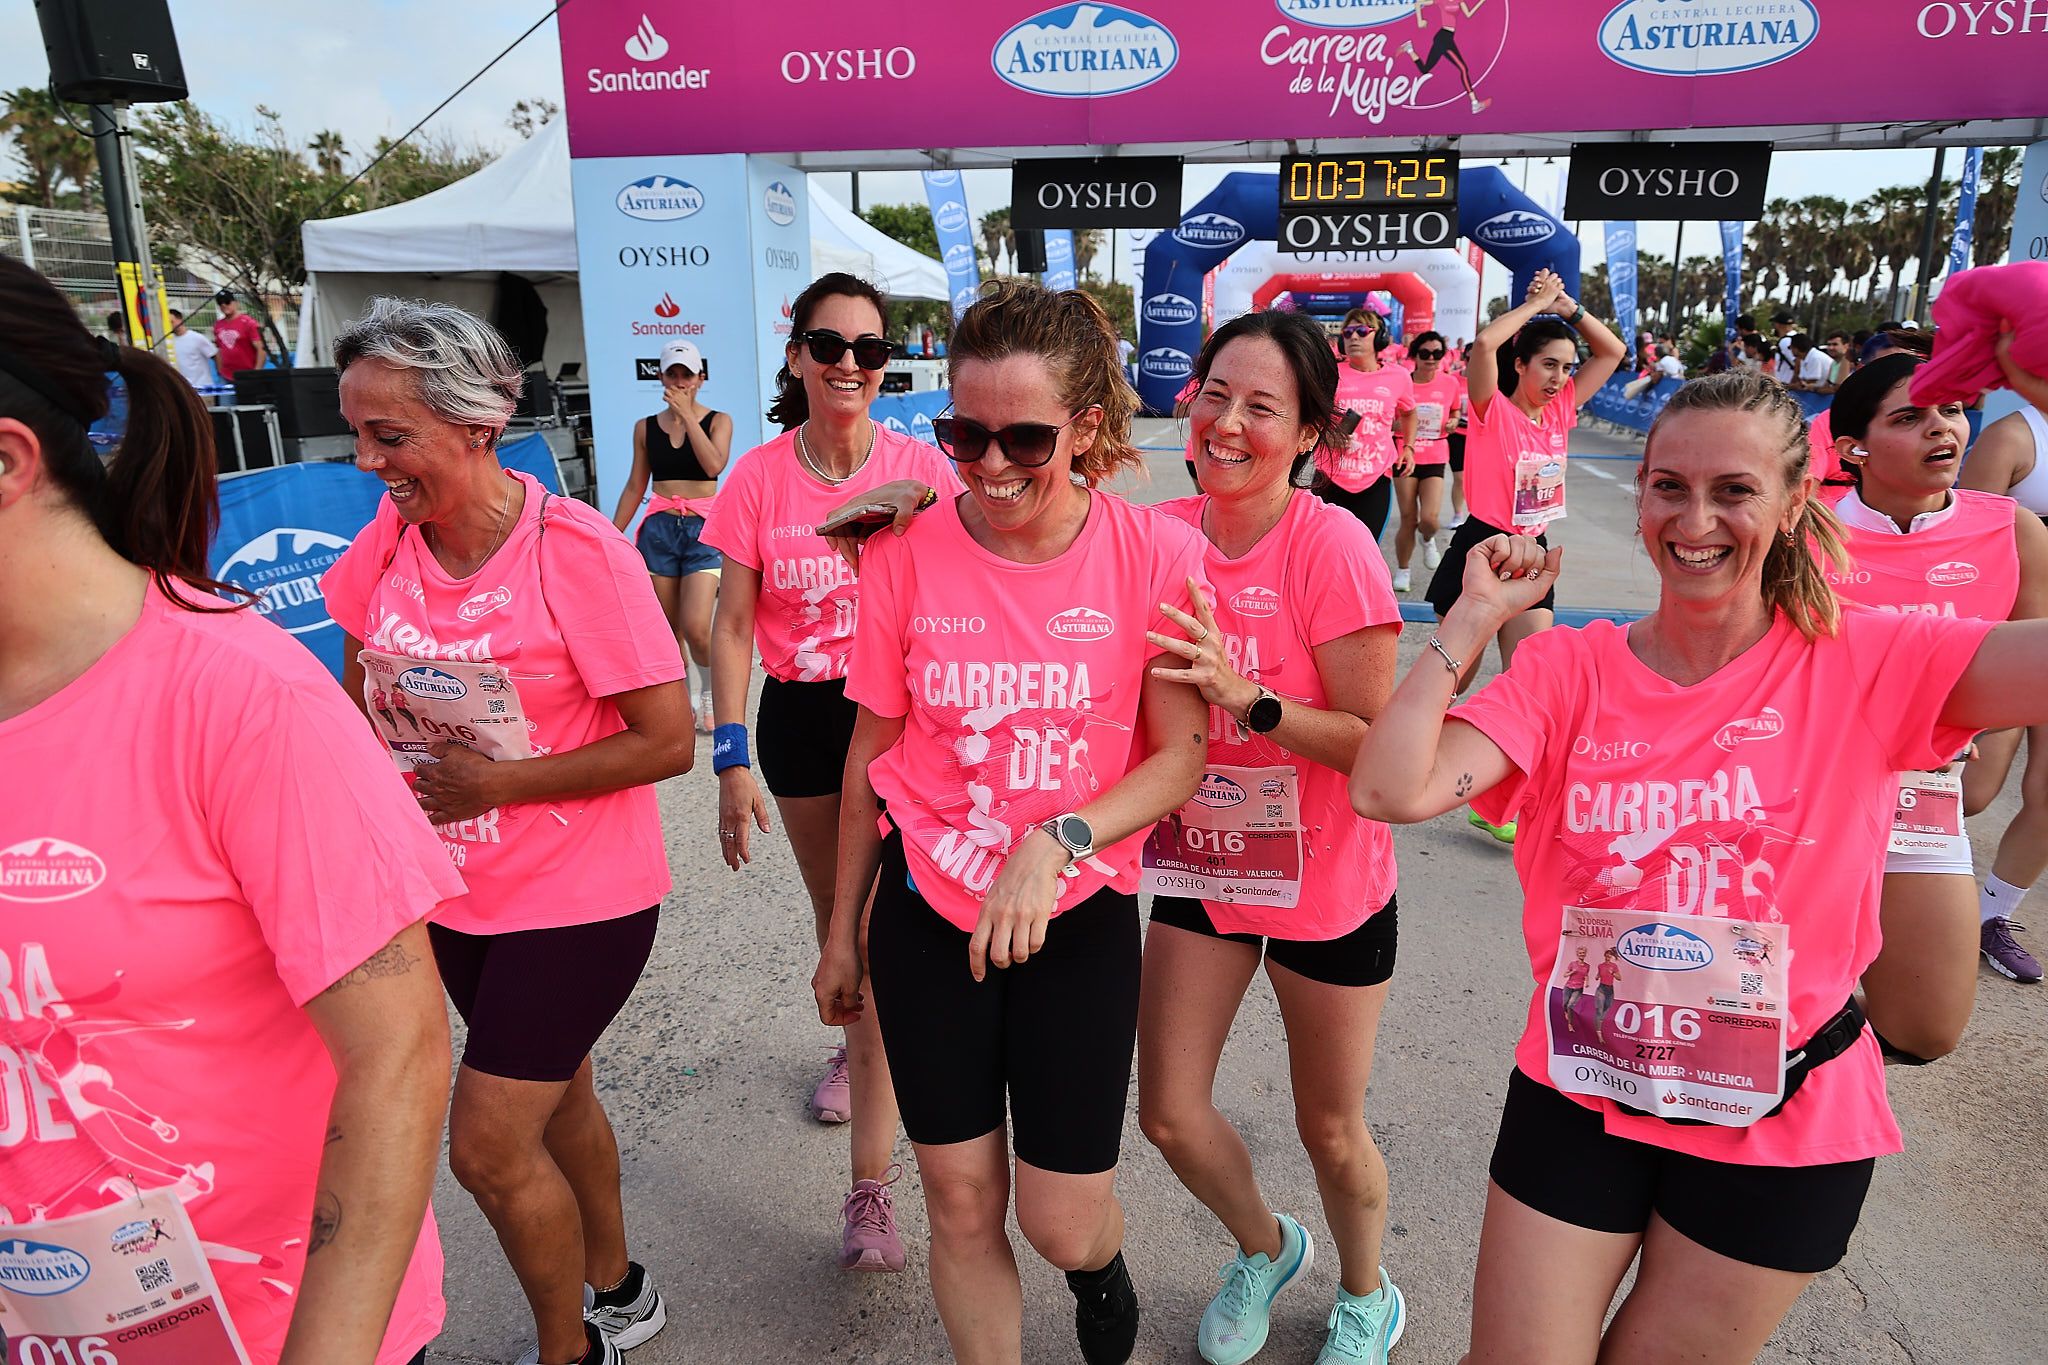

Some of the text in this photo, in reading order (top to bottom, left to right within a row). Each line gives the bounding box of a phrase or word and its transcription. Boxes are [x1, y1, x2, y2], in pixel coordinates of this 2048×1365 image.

[1649, 4, 1797, 20] CENTRAL LECHERA
[1033, 32, 1159, 46] CENTRAL LECHERA
[1613, 14, 1800, 52] ASTURIANA
[1006, 40, 1164, 74] ASTURIANA
[1260, 25, 1388, 66] Carrera
[780, 46, 917, 84] OYSHO
[587, 64, 711, 93] Santander
[1289, 57, 1433, 124] de la Mujer
[1289, 157, 1447, 201] 00:37:25
[1598, 167, 1740, 198] OYSHO
[623, 194, 698, 211] ASTURIANA
[1038, 181, 1157, 210] OYSHO
[1177, 224, 1239, 241] ASTURIANA
[1285, 211, 1450, 248] OYSHO
[1480, 223, 1551, 240] ASTURIANA
[619, 245, 710, 268] OYSHO
[766, 247, 799, 271] OYSHO
[1146, 304, 1194, 318] ASTURIANA
[632, 321, 706, 336] Santander
[771, 523, 813, 540] OYSHO
[248, 562, 302, 584] CENTRAL
[913, 616, 986, 634] OYSHO
[1051, 620, 1111, 635] ASTURIANA
[405, 676, 463, 695] ASTURIANA
[923, 660, 1092, 711] CARRERA
[420, 715, 478, 742] 016
[1006, 725, 1070, 792] DE
[1572, 735, 1651, 762] OYSHO
[1565, 765, 1767, 834] CARRERA
[1185, 827, 1246, 854] 016
[1903, 839, 1949, 849] Santander
[1156, 858, 1189, 871] CARRERA
[1190, 864, 1200, 873] DE
[1200, 866, 1211, 875] LA
[1212, 868, 1239, 877] MUJER
[1245, 869, 1284, 878] VALENCIA
[1206, 855, 1227, 866] 401
[1156, 875, 1206, 890] OYSHO
[1235, 886, 1282, 898] Santander
[1579, 925, 1615, 939] SUMA
[1623, 938, 1706, 964] ASTURIANA
[1666, 940, 1703, 949] LECHERA
[1614, 1002, 1702, 1041] 016
[1708, 1014, 1777, 1030] CORREDORA
[1635, 1044, 1676, 1061] 2727
[1572, 1043, 1615, 1065] CARRERA
[1616, 1057, 1630, 1070] DE
[1631, 1062, 1646, 1074] LA
[1649, 1064, 1686, 1078] MUJER
[1696, 1070, 1755, 1088] VALENCIA
[1574, 1066, 1637, 1095] OYSHO
[1679, 1093, 1753, 1116] Santander
[116, 1303, 212, 1343] CORREDORA
